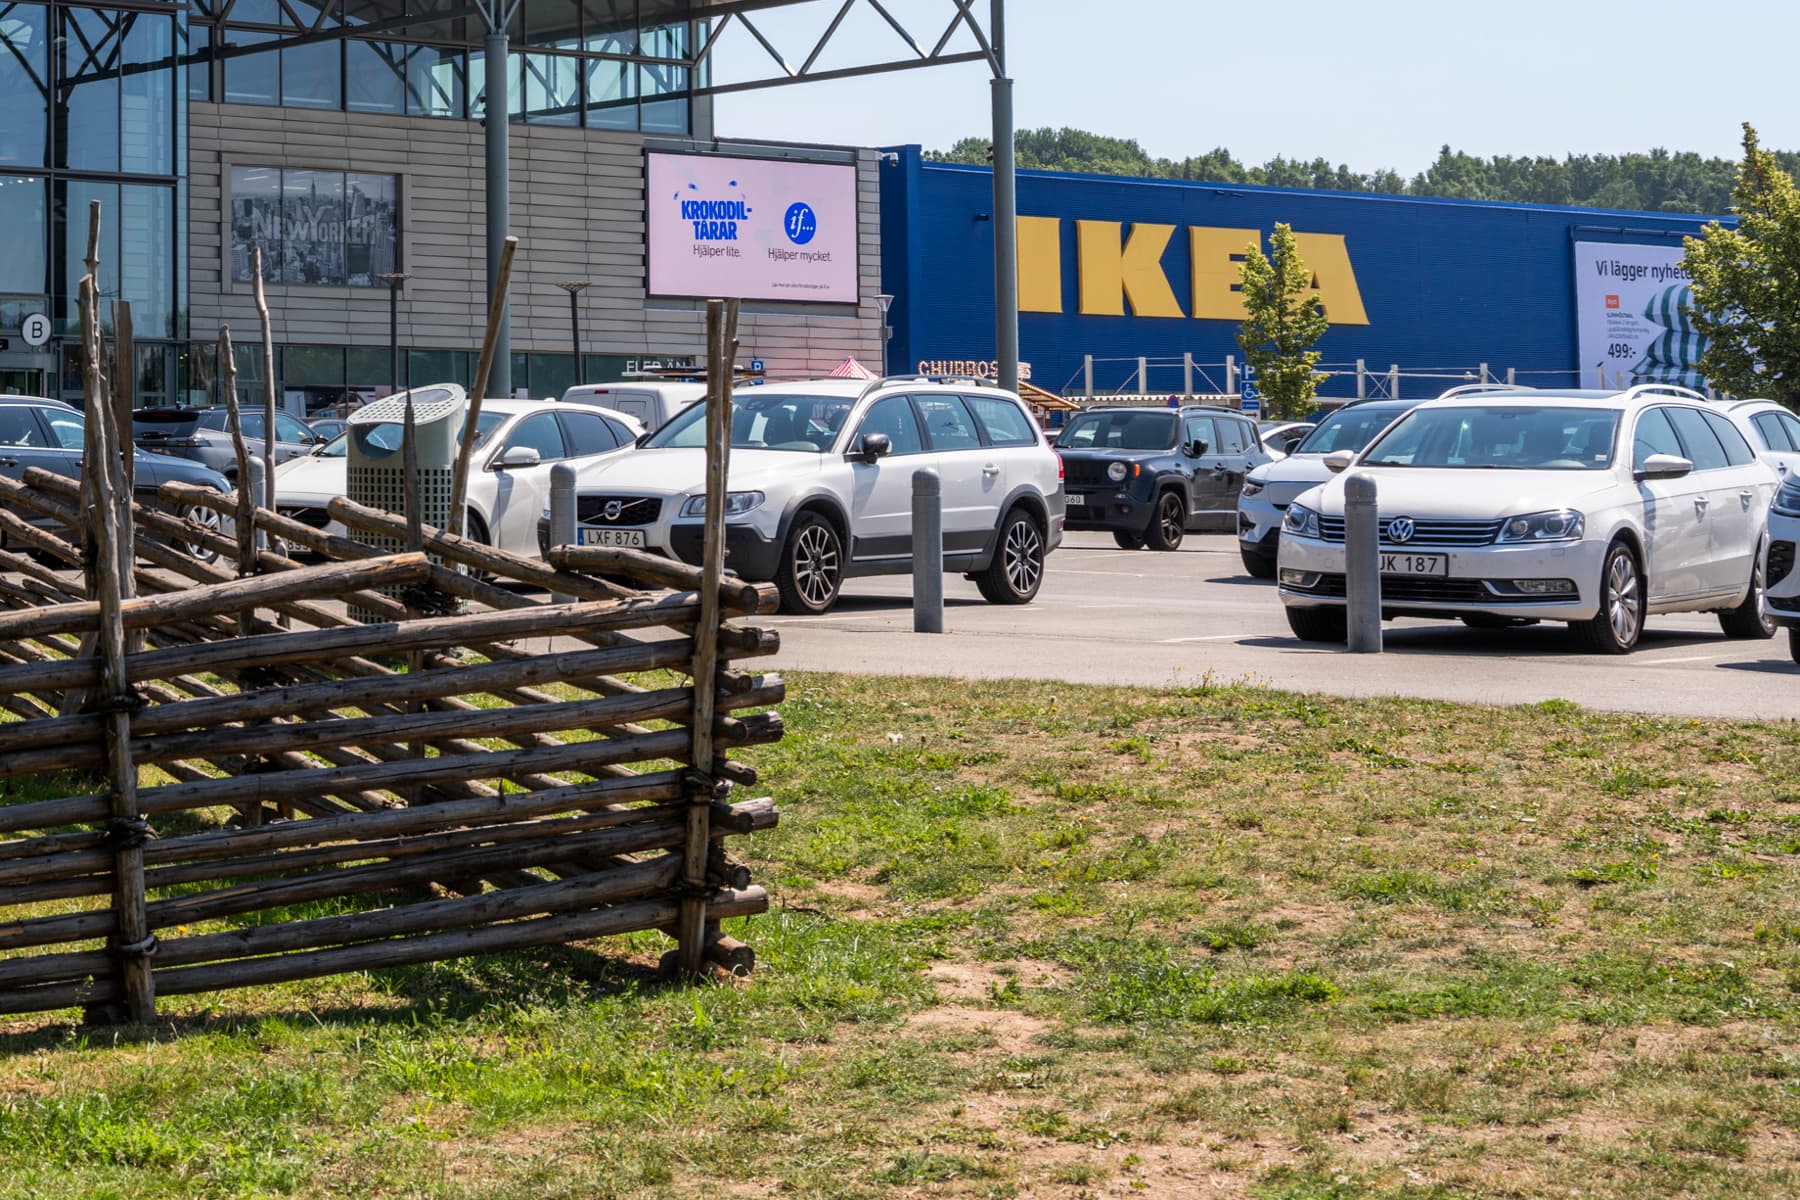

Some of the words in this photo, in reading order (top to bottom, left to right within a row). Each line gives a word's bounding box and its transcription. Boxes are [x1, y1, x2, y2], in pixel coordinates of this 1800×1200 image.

[681, 200, 752, 220] KROKODIL-
[693, 220, 737, 240] TÅRAR
[693, 244, 725, 258] Hjälper
[768, 248, 799, 261] Hjälper
[1016, 215, 1371, 326] IKEA
[1596, 260, 1608, 276] Vi
[1611, 260, 1648, 281] lägger
[32, 321, 43, 339] B
[1607, 343, 1637, 359] 499:-
[918, 360, 999, 378] CHURROS
[1245, 365, 1256, 379] P
[588, 530, 611, 545] LXF
[615, 532, 640, 546] 876
[1379, 555, 1396, 571] JK
[1405, 556, 1438, 573] 187
